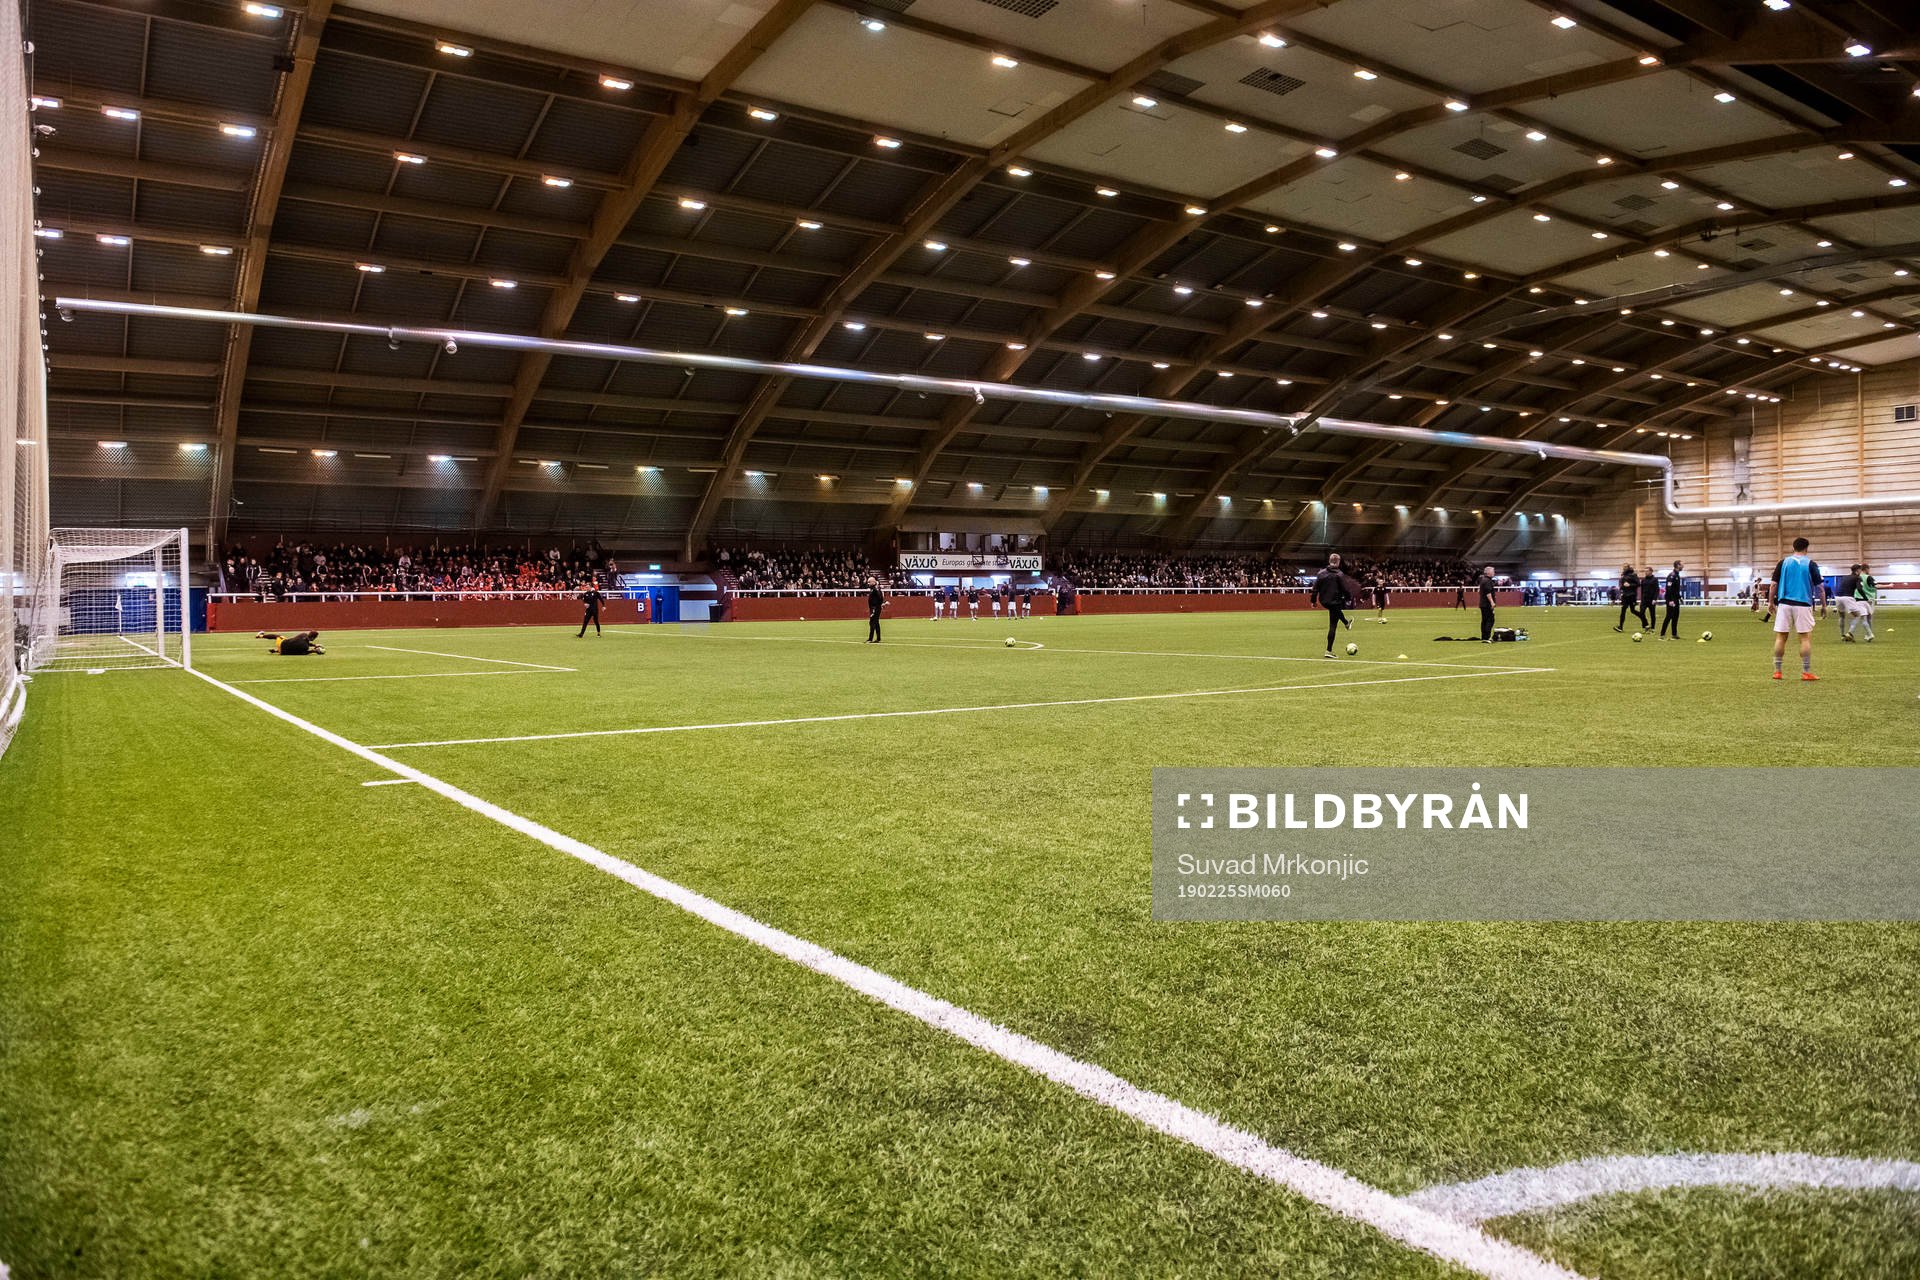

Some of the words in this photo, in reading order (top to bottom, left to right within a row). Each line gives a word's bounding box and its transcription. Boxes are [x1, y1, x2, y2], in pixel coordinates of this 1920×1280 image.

[905, 556, 938, 568] VÄXJÖ
[942, 559, 965, 567] Europas
[1009, 557, 1039, 569] VÄXJÖ
[637, 602, 645, 612] B
